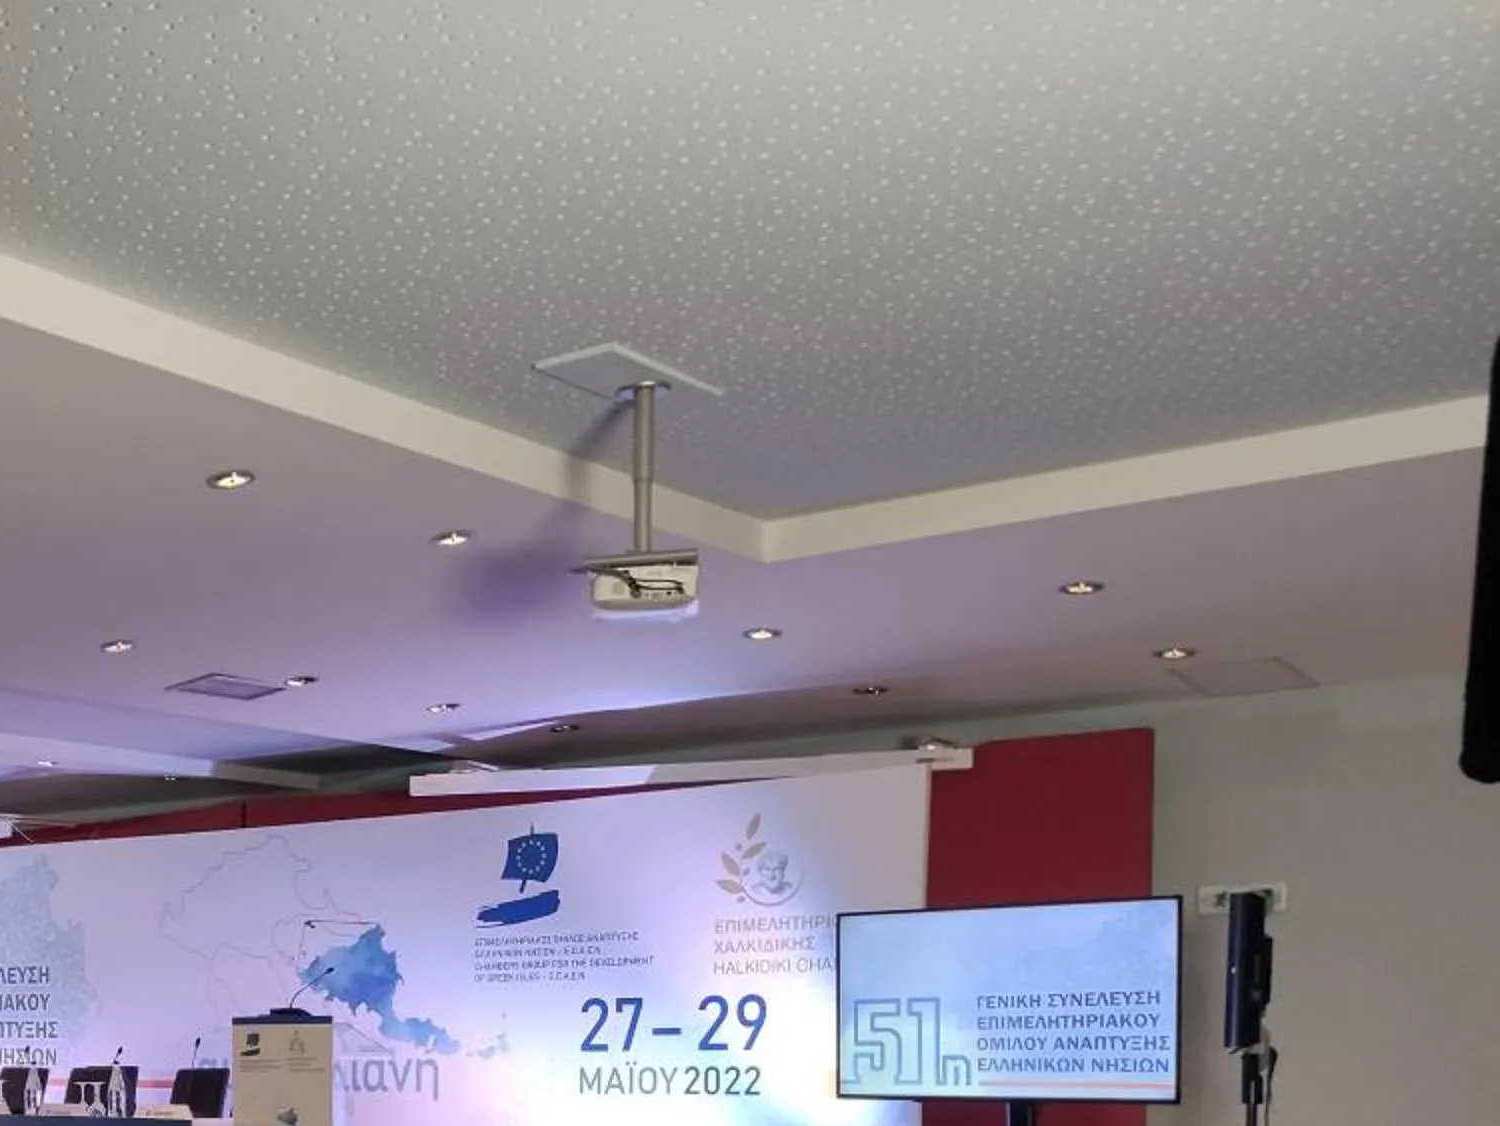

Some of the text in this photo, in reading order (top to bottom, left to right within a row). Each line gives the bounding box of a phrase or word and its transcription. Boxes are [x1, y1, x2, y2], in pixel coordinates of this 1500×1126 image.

[713, 935, 816, 954] ΧΑΛΚΙΔΙΚΗΣ
[712, 957, 837, 976] HALKIDIKI CHA
[976, 990, 1162, 1011] ΓΕΝΙΚΗ ΣΥΝΕΛΕΥΣΗ
[976, 1013, 1160, 1031] ΕΠΙΜΕΛΗΤΗΡΙΑΚΟΥ
[976, 1034, 1171, 1052] ΟΜΙΛΟΥ ΑΝΑΠΤΥΞΗΣ
[976, 1056, 1170, 1075] ΕΛΛΗΝΙΚΩΝ ΝΗΣΙΩΝ
[578, 1061, 762, 1096] ΜΑΪΟΥ 2022
